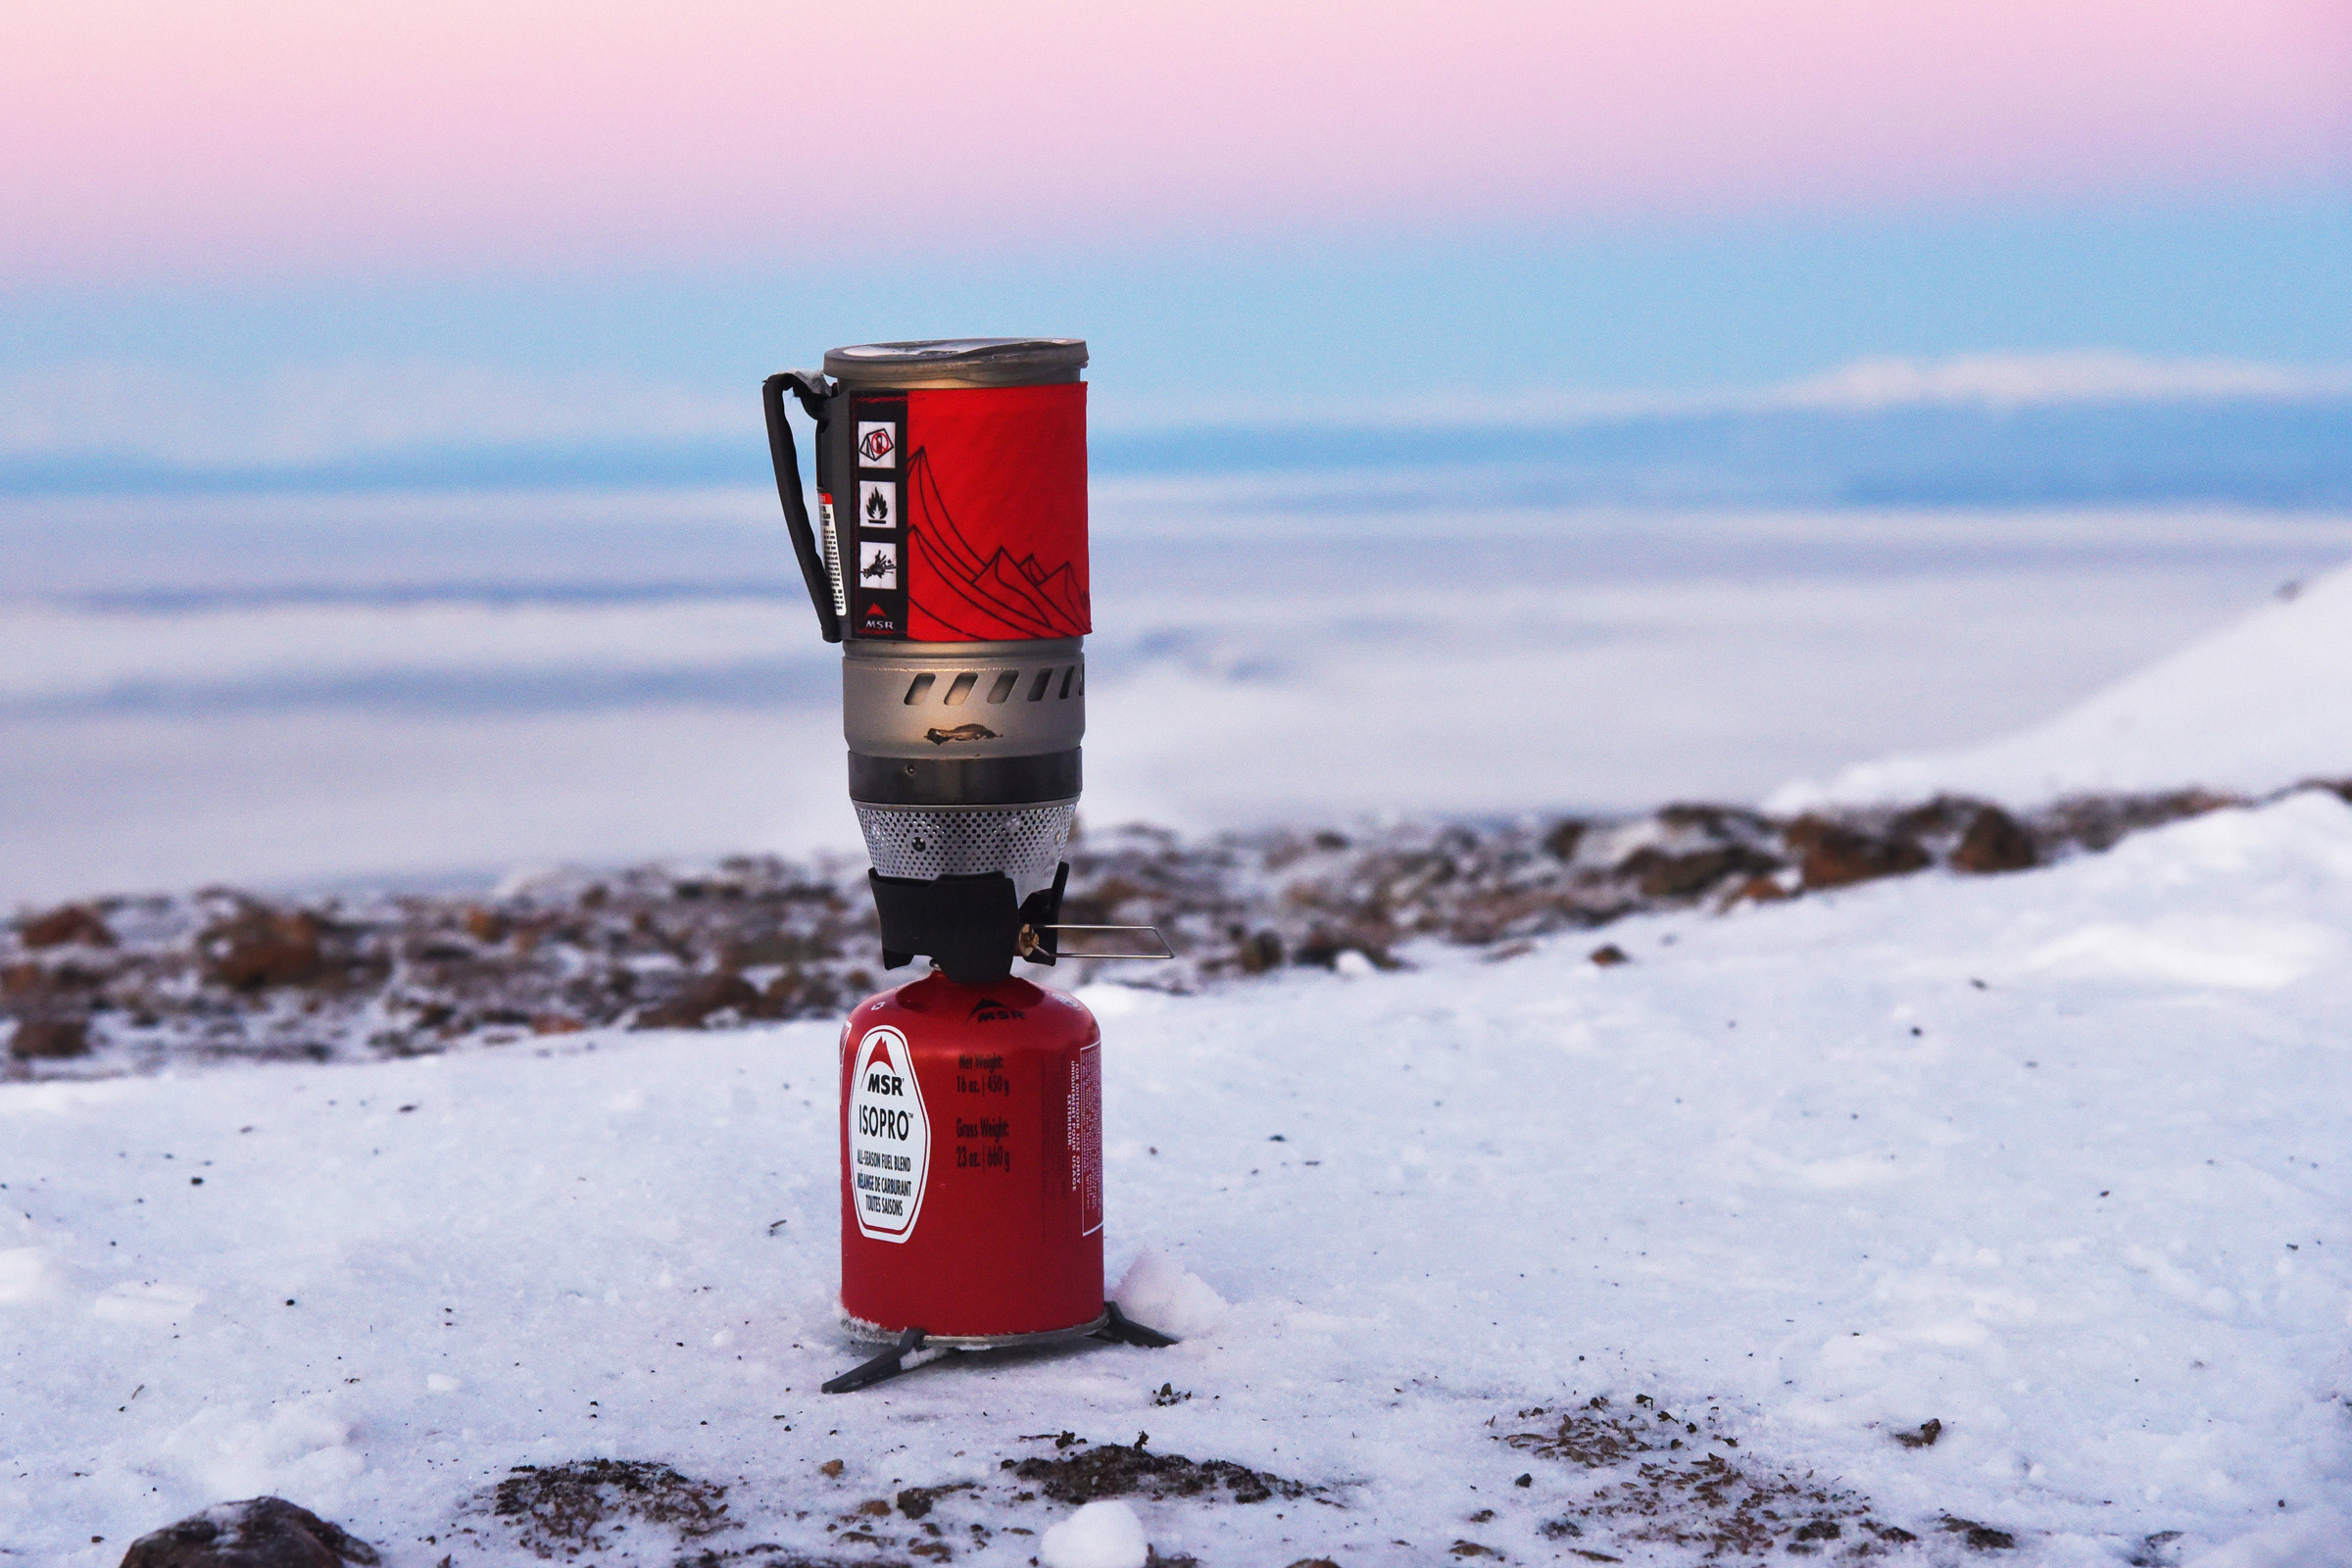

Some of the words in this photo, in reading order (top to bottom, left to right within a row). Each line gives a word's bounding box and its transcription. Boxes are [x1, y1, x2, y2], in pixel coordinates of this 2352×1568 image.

[865, 619, 895, 630] MSR
[977, 1010, 1026, 1023] MSR
[867, 1073, 904, 1096] MSR
[956, 1075, 966, 1093] 16
[987, 1076, 1003, 1093] 450
[1004, 1079, 1009, 1097] g
[956, 1118, 978, 1138] Gross
[881, 1153, 893, 1170] FUEL
[894, 1155, 911, 1172] BLEND
[956, 1145, 966, 1167] 23
[1004, 1151, 1010, 1173] g
[874, 1176, 881, 1193] DE
[881, 1177, 911, 1197] CARBURANT
[865, 1195, 881, 1212] TOUTES
[881, 1198, 904, 1216] SAISONS
